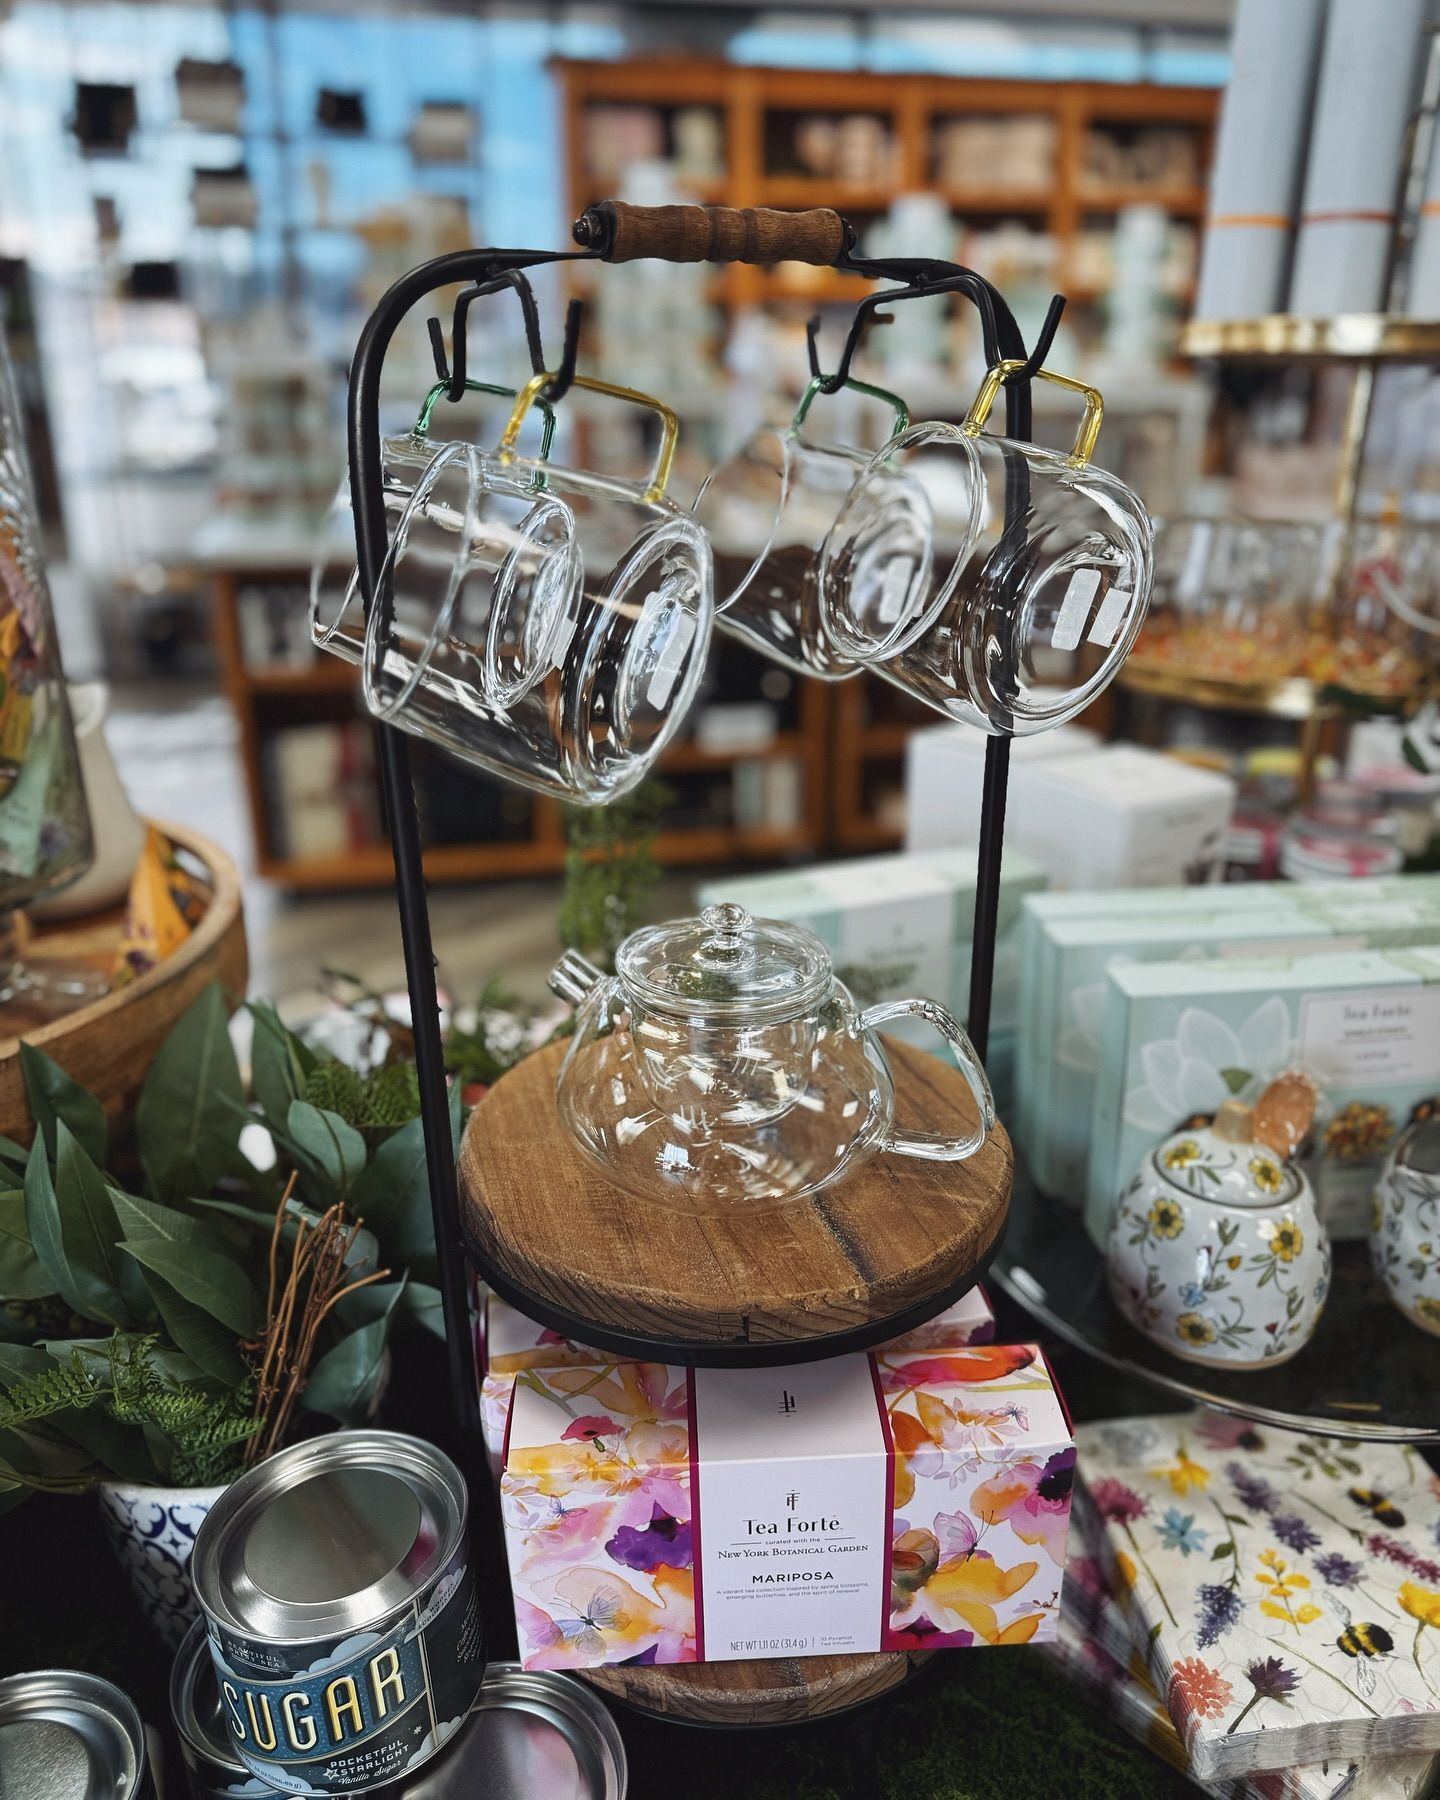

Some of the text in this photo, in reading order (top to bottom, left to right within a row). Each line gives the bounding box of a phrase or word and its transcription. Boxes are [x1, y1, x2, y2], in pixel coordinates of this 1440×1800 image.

[742, 1519, 778, 1535] Tea
[752, 1571, 834, 1583] MARIPOSA
[731, 1641, 743, 1651] NET
[745, 1640, 757, 1650] WT
[770, 1639, 780, 1649] OZ
[798, 1638, 808, 1649] g)
[261, 1660, 280, 1668] SEA
[223, 1647, 405, 1750] SUGAR
[330, 1740, 403, 1768] POCKETFUL
[340, 1744, 409, 1776] STARLIGHT
[338, 1760, 402, 1785] Vanilla Sugar
